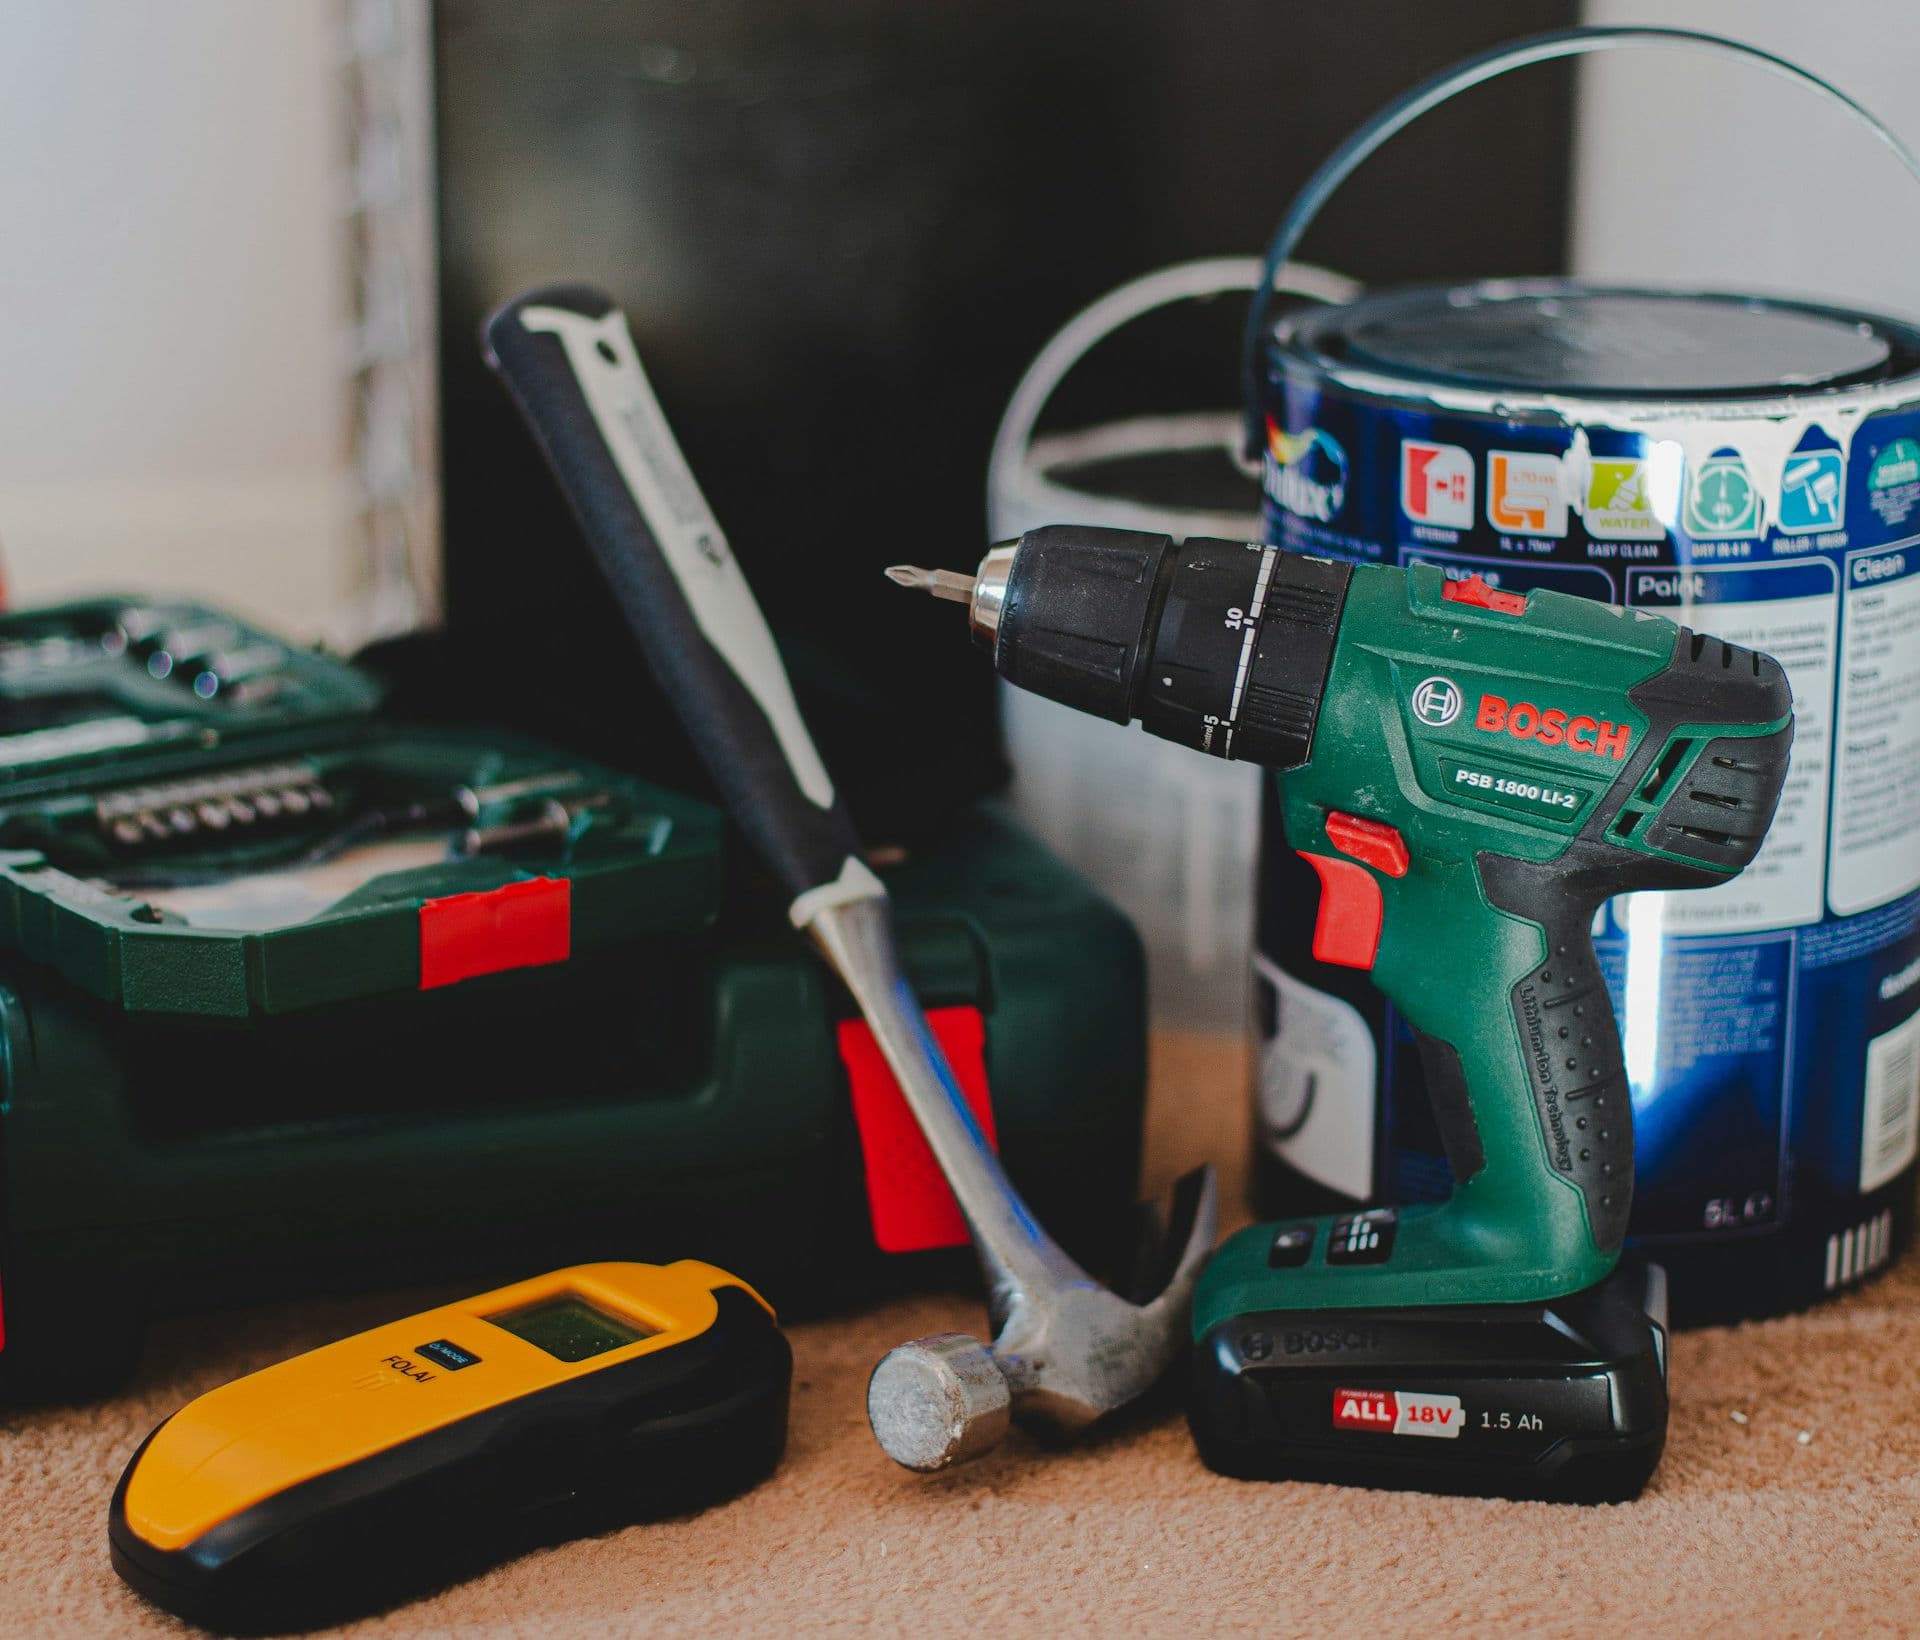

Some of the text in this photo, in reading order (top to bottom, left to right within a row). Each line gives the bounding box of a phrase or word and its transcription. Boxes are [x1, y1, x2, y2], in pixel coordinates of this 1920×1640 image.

[1600, 517, 1650, 528] WATER
[1587, 543, 1658, 558] EASY CLEAN
[1853, 554, 1905, 582] Clean
[1638, 575, 1705, 597] Paint
[1225, 607, 1244, 631] 10
[1204, 715, 1219, 726] 5
[1475, 694, 1631, 760] BOSCH
[1455, 769, 1578, 808] PSB 1800 LI-2
[1543, 1086, 1573, 1171] Technology
[1284, 1329, 1381, 1354] BOSCH
[381, 1355, 437, 1383] FOLAI
[1340, 1399, 1392, 1421] ALL
[1407, 1405, 1453, 1425] 18V
[1481, 1412, 1543, 1431] 1.5 Ah
